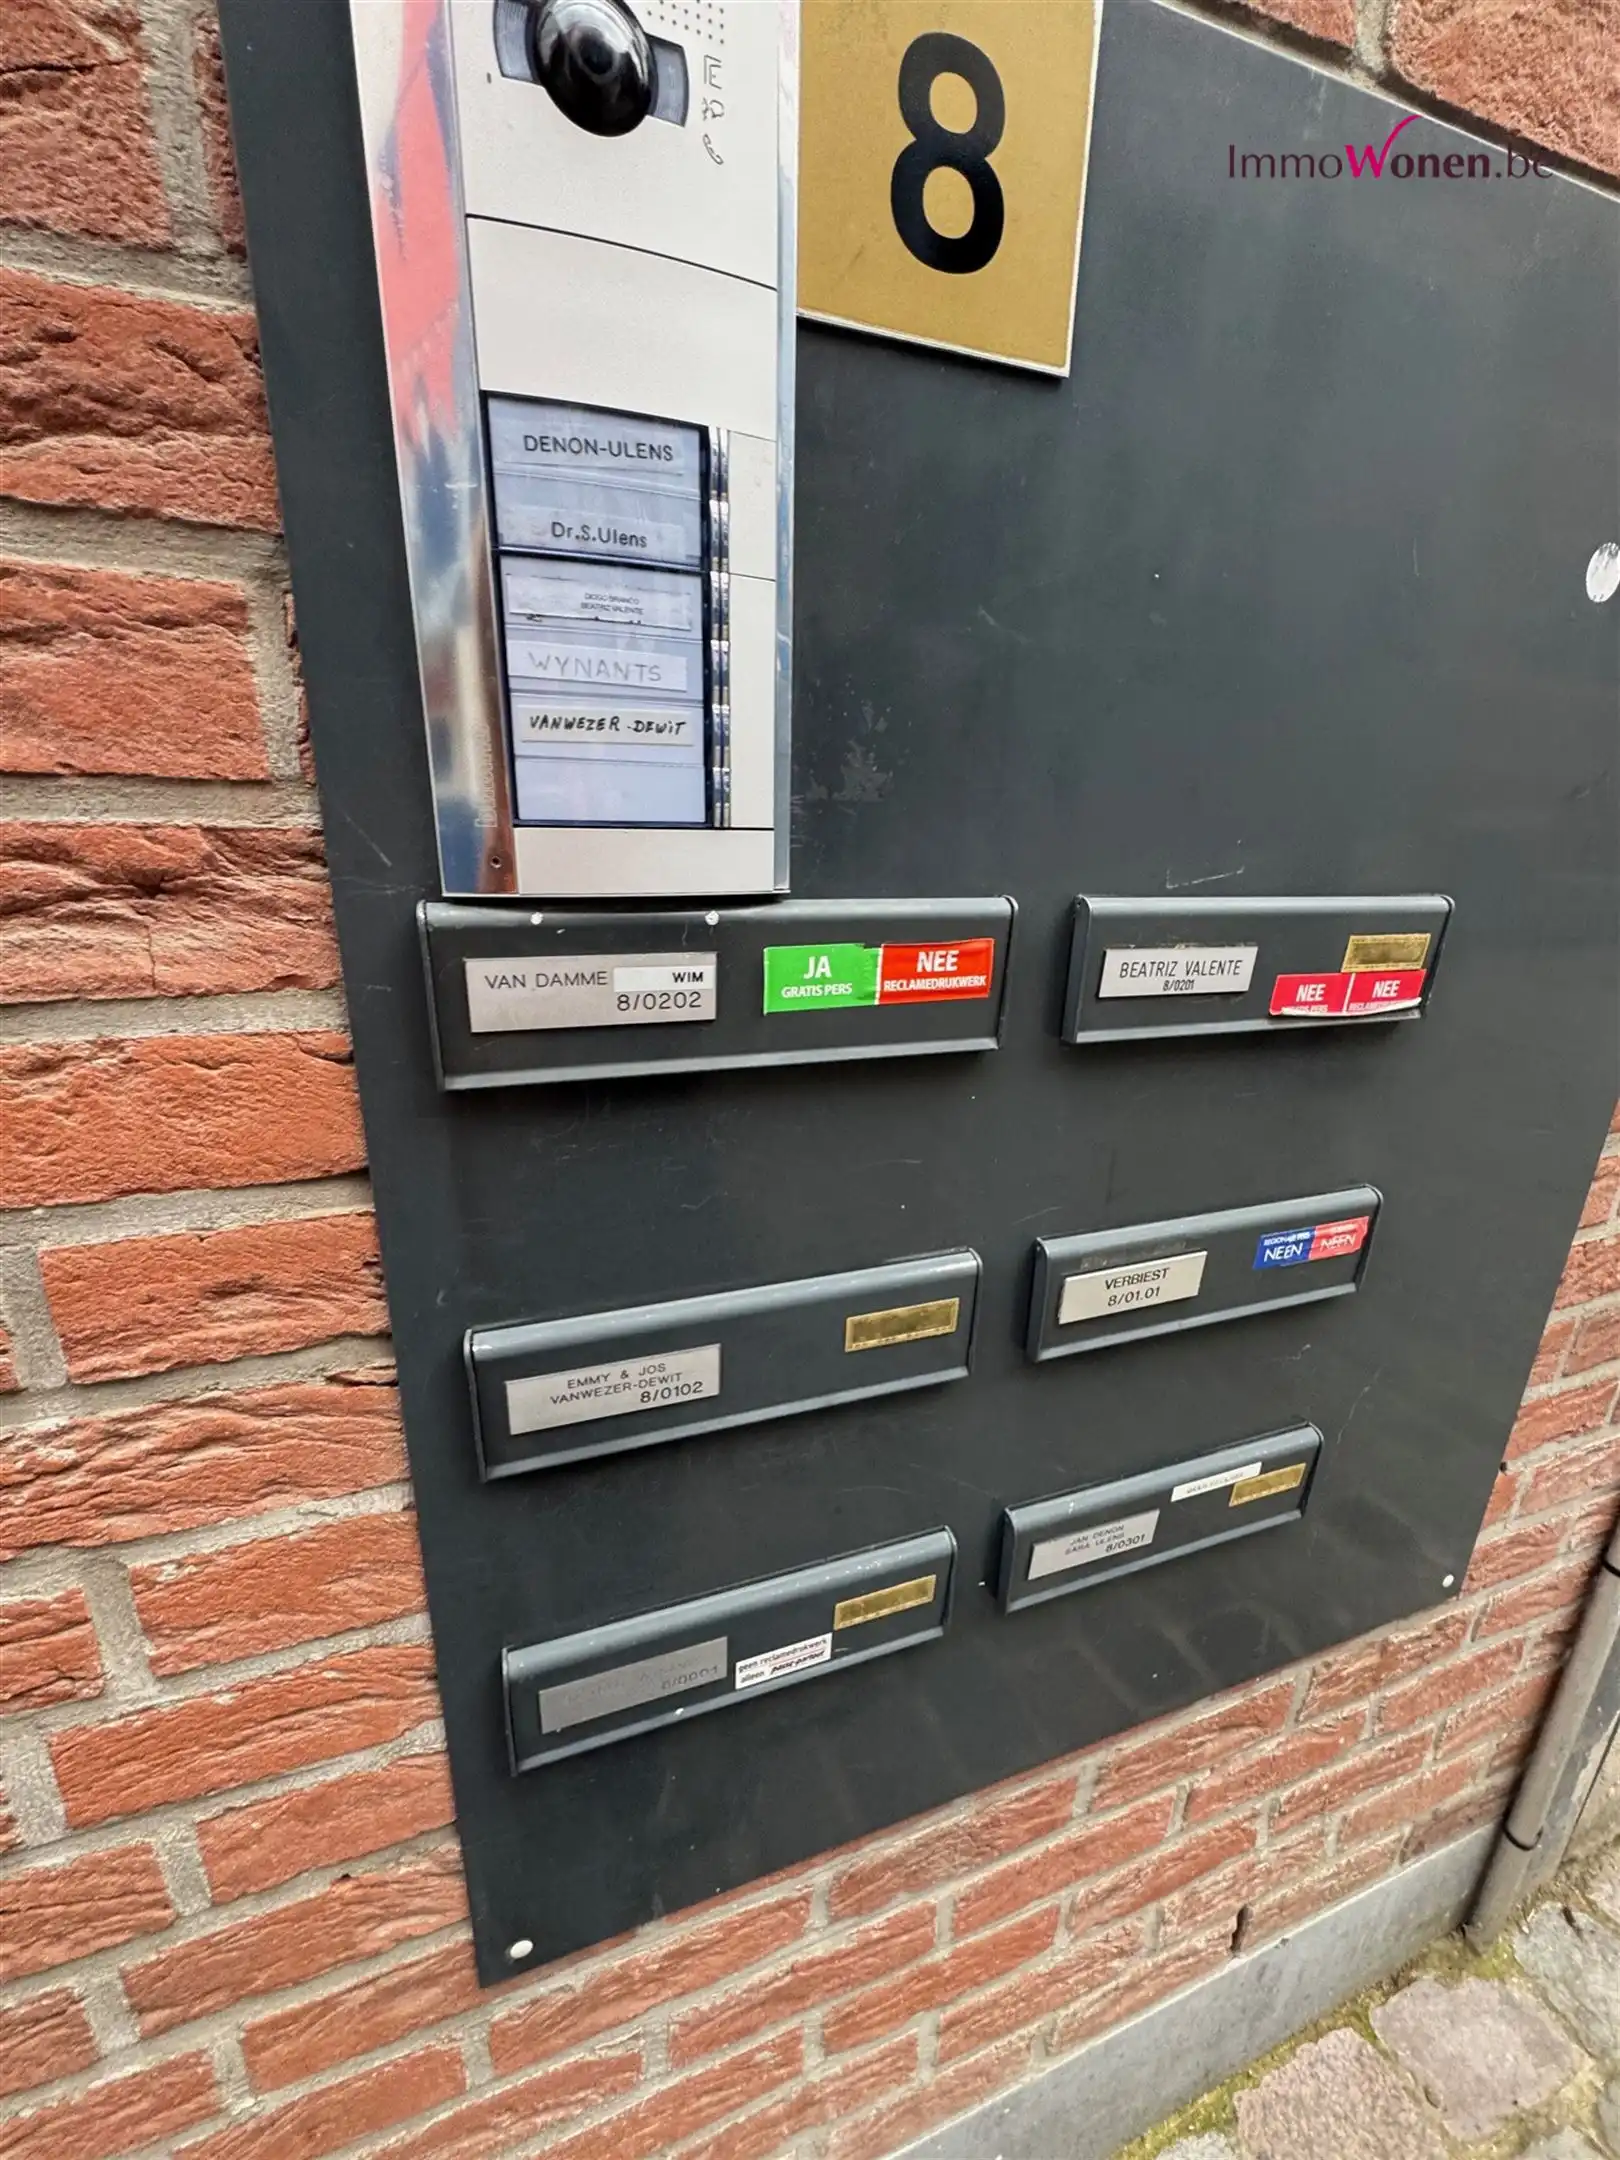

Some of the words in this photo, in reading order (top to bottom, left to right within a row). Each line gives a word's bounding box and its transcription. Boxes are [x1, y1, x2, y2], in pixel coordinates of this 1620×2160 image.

[890, 32, 1006, 274] 8
[523, 435, 674, 461] DENON-ULENS
[551, 522, 648, 548] Dr.S.Ulens
[528, 652, 662, 682] WYNANTS
[803, 956, 832, 979] JA
[916, 949, 960, 973] NEE
[1119, 961, 1178, 978] BEATRIZ
[1185, 960, 1243, 976] VALENTE
[484, 974, 526, 990] VAN
[535, 971, 608, 988] DAMME
[672, 971, 704, 983] WIM
[781, 984, 823, 998] GRATIS
[824, 983, 853, 996] PERS
[883, 975, 987, 992] RECLAMEDRUKWERK
[1372, 980, 1401, 998] NEE
[616, 991, 702, 1012] 8/0202
[1295, 984, 1326, 1003] NEE
[1263, 1242, 1303, 1262] NEEN
[1105, 1267, 1170, 1290] VERBIEST
[1107, 1286, 1161, 1307] 8/01.01
[567, 1373, 610, 1389] EMMY
[620, 1369, 629, 1379] &
[639, 1363, 667, 1376] JOS
[550, 1372, 683, 1405] VANWEZER-DEWIT
[640, 1381, 703, 1404] 8/0102
